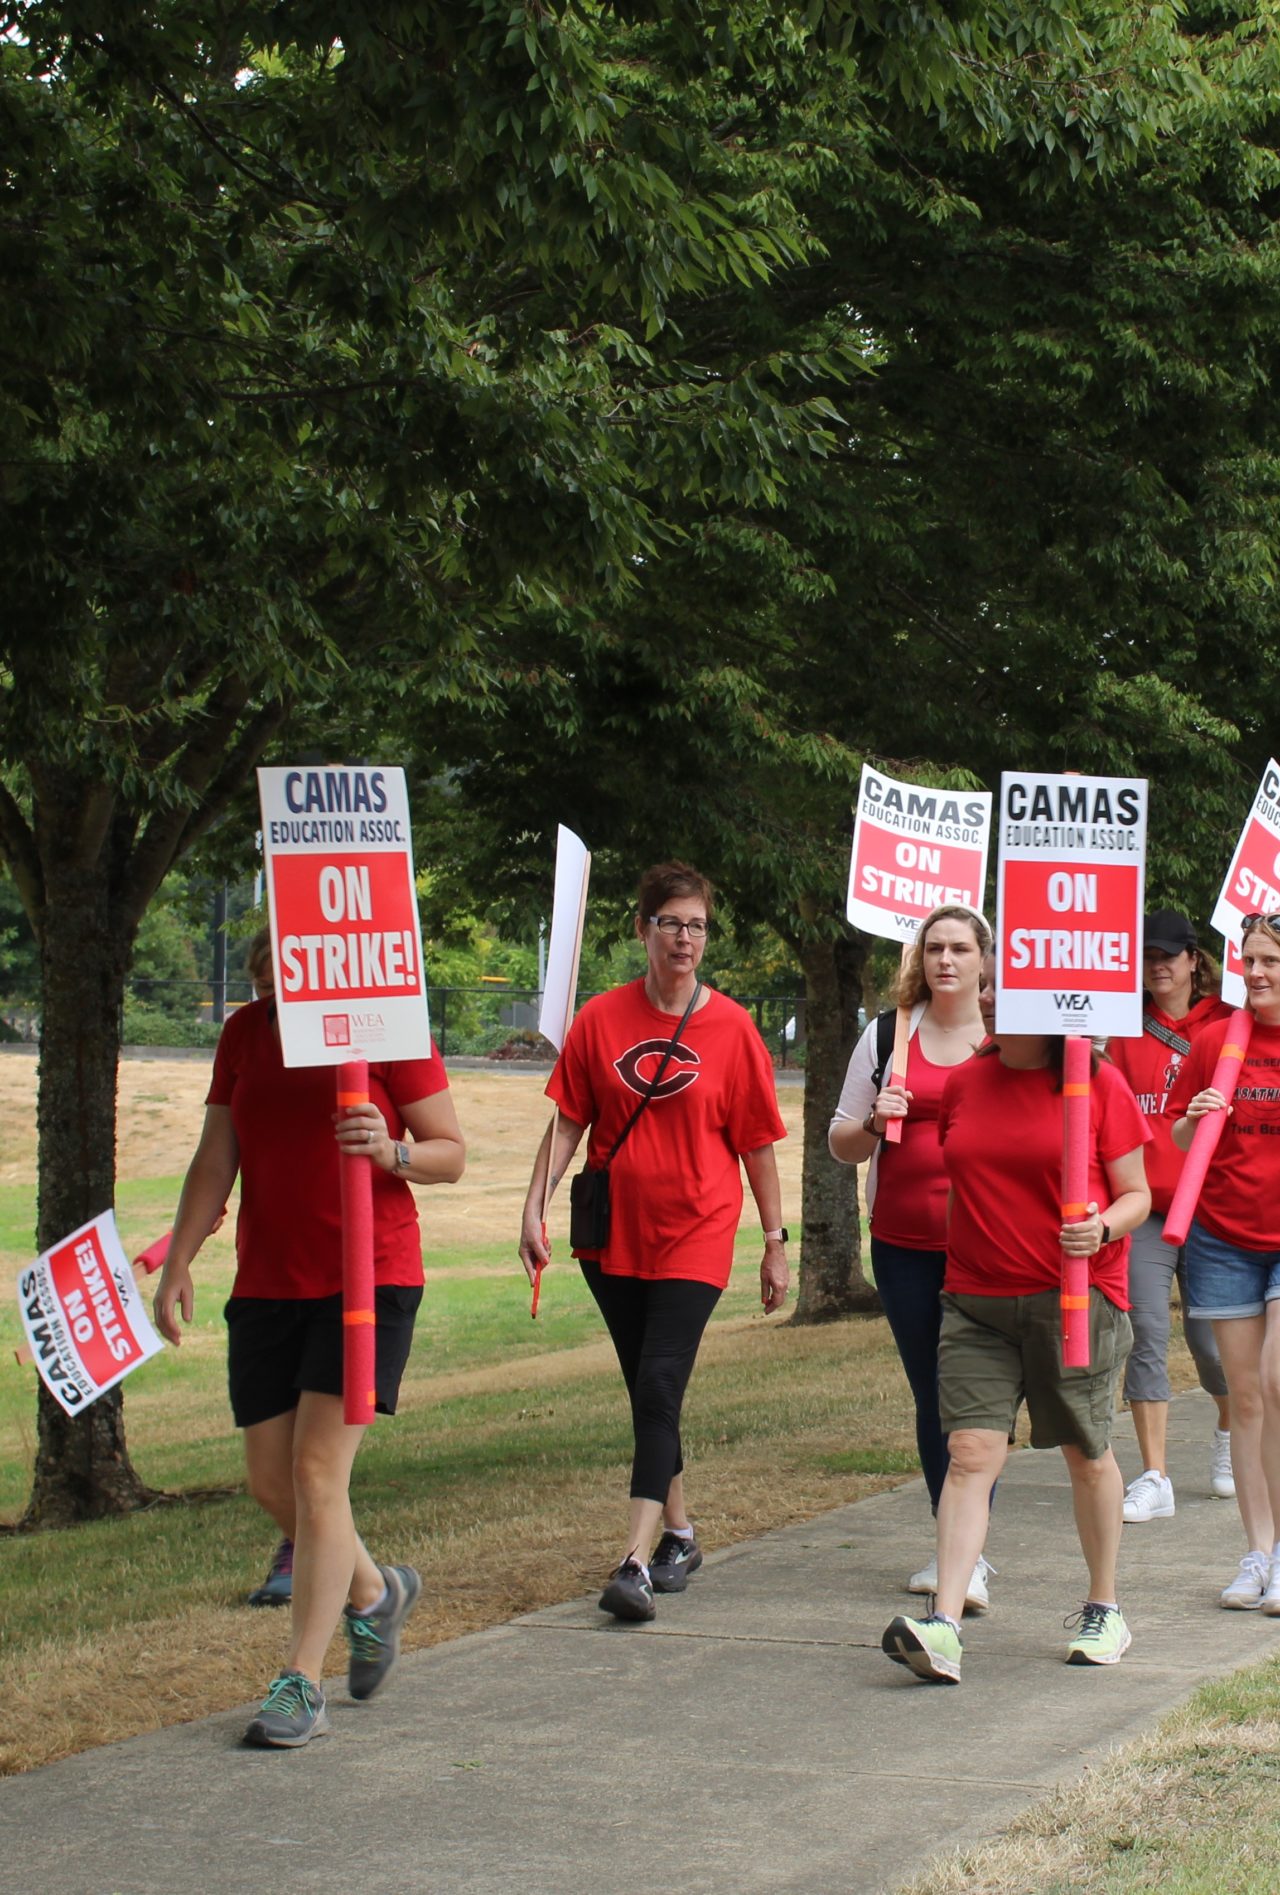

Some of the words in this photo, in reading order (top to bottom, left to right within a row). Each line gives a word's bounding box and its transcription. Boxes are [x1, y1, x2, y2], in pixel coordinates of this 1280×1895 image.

[285, 771, 387, 814] CAMAS
[864, 776, 985, 827] CAMAS
[1007, 783, 1139, 826] CAMAS
[270, 820, 354, 844] EDUCATION
[360, 820, 406, 842] ASSOC.
[862, 799, 931, 834] EDUCATION
[935, 824, 983, 845] ASSOC.
[1005, 825, 1086, 848] EDUCATION
[1089, 828, 1140, 851] ASSOC.
[895, 841, 941, 874] ON
[319, 865, 373, 923] ON
[1048, 871, 1098, 913] ON
[894, 914, 920, 930] WE
[281, 930, 417, 992] STRIKE!
[1010, 928, 1130, 972] STRIKE!
[351, 1013, 385, 1027] WEA
[1053, 993, 1094, 1011] WEA
[64, 1288, 94, 1343] ON
[74, 1238, 131, 1361] STRIKE!
[22, 1270, 83, 1406] CAMAS
[50, 1318, 94, 1397] EDUCATION
